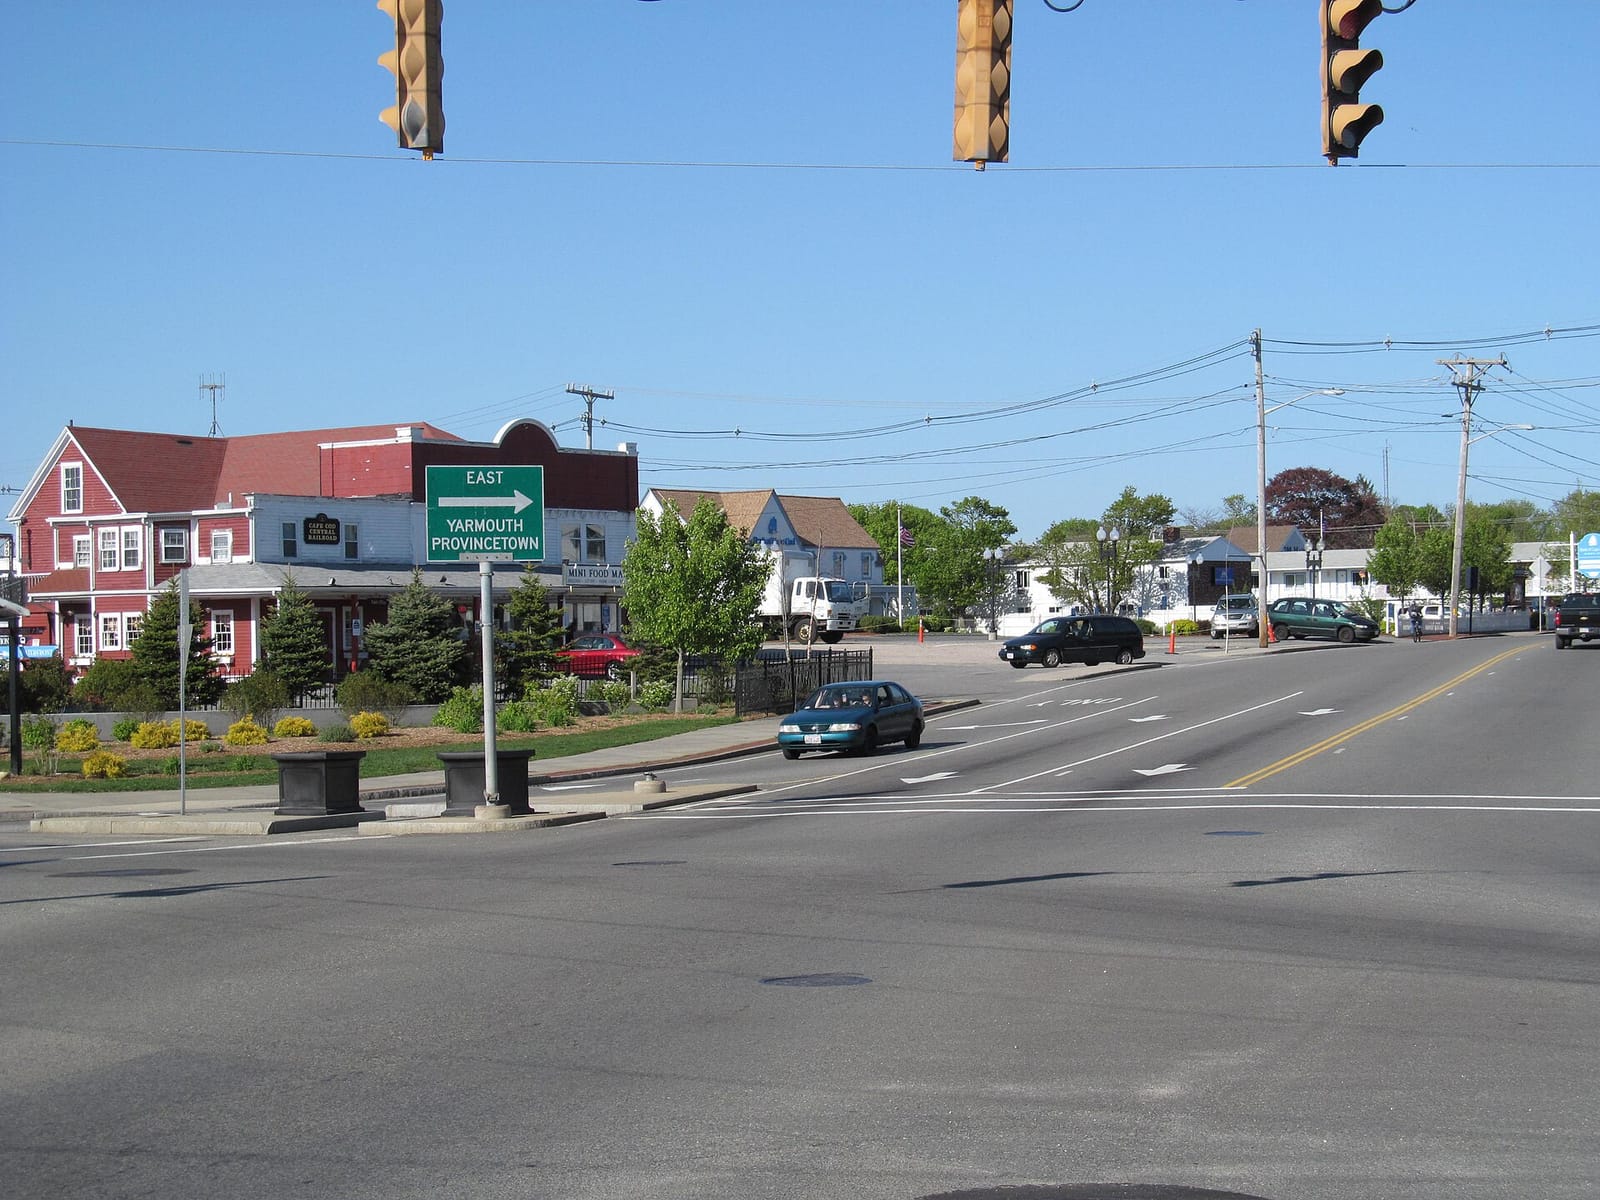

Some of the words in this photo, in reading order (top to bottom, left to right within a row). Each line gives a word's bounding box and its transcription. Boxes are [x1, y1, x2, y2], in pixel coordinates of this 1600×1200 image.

[466, 471, 504, 484] EAST
[446, 518, 524, 532] YARMOUTH
[431, 537, 539, 551] PROVINCETOWN
[568, 568, 586, 577] MINI
[589, 569, 609, 578] FOOD
